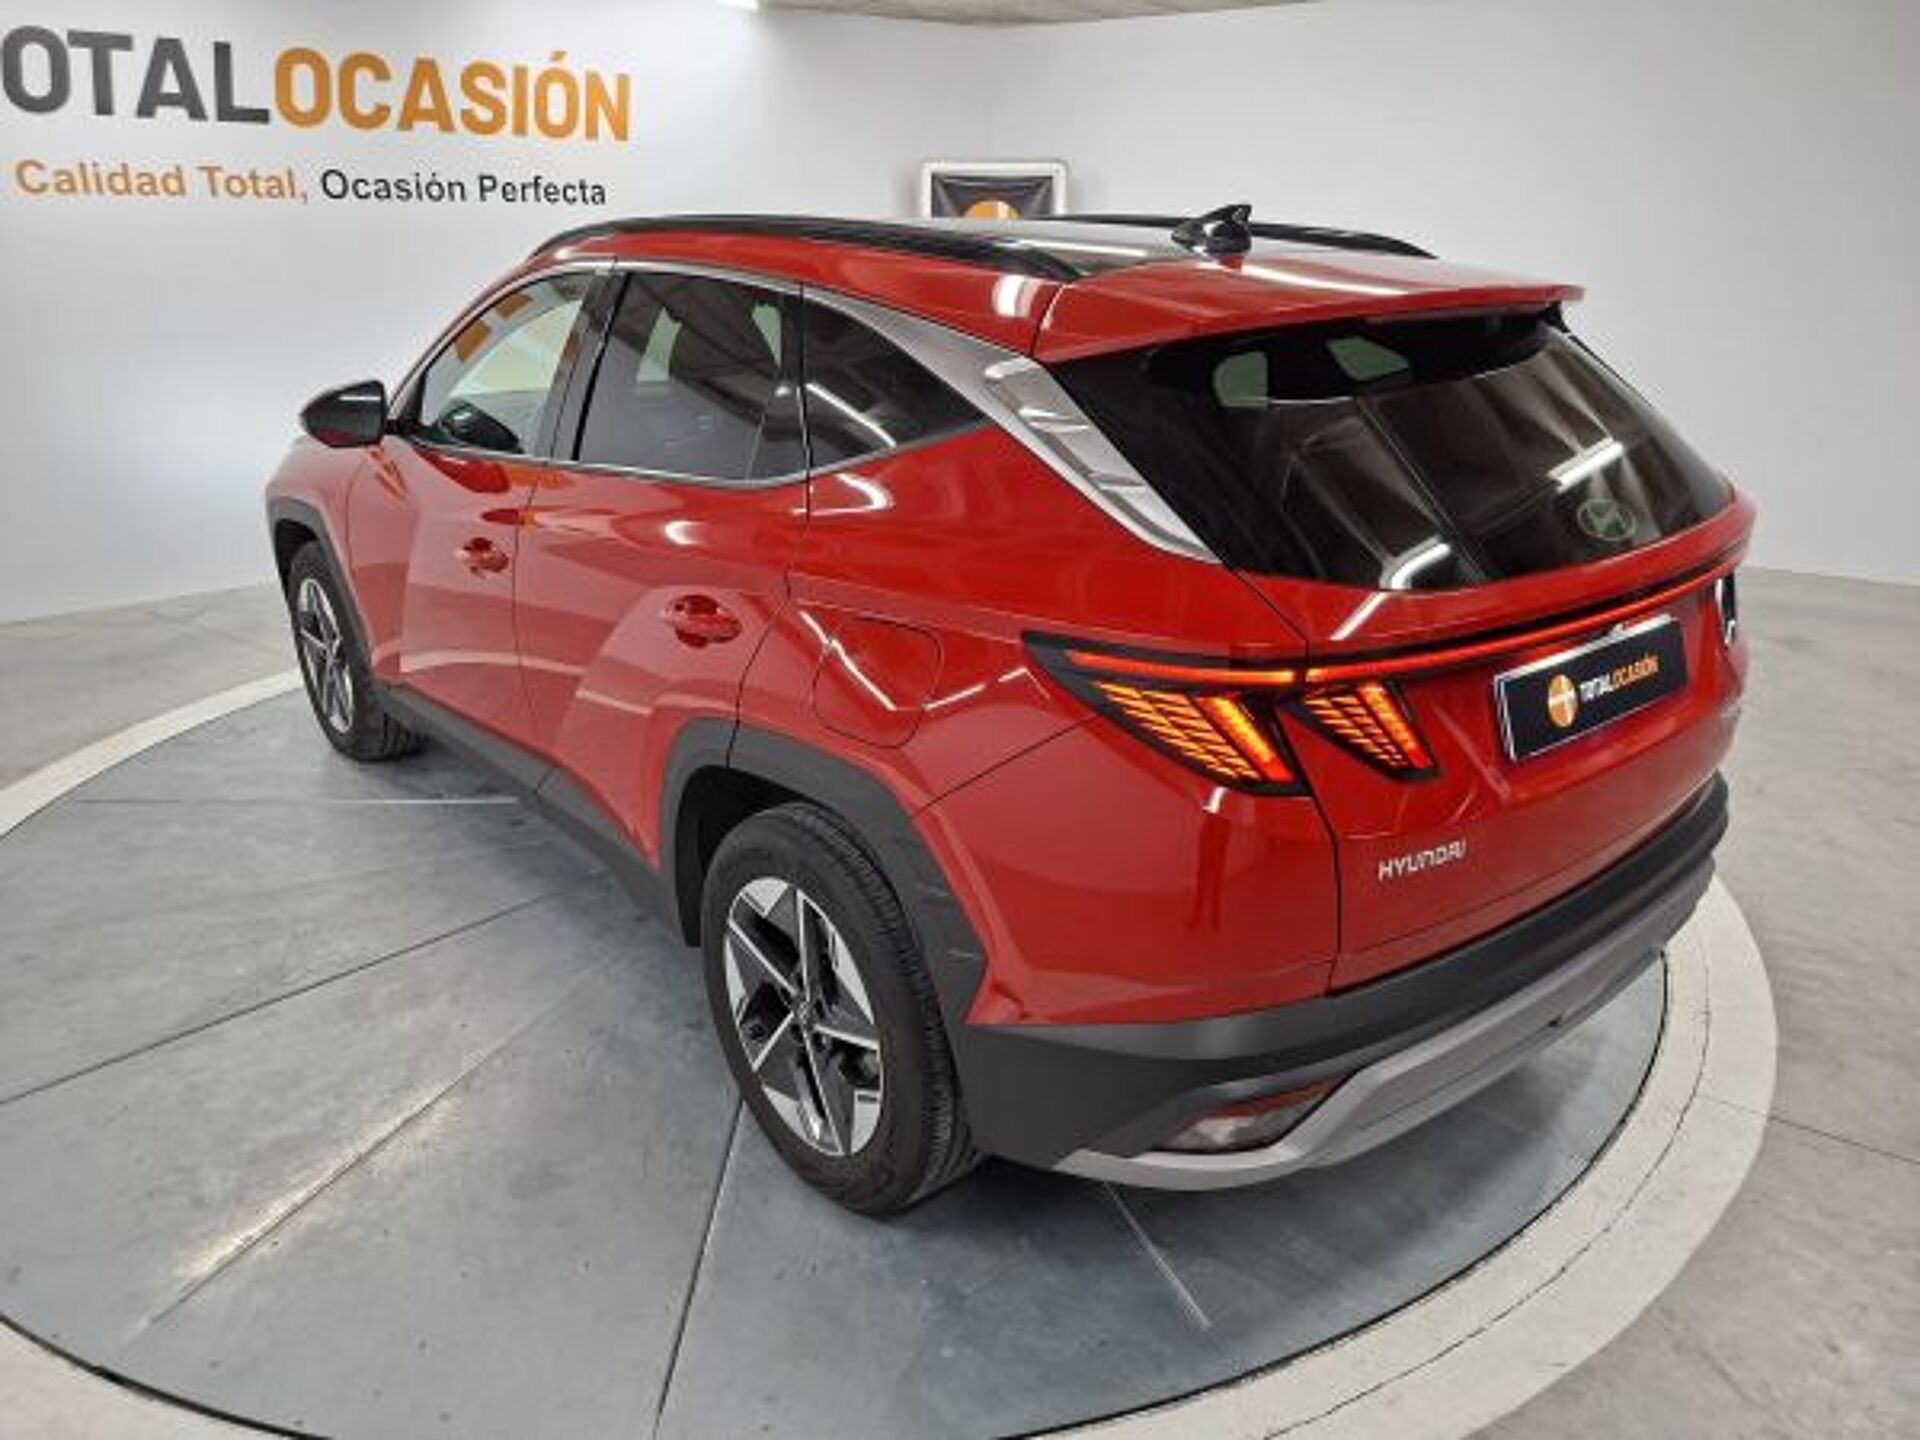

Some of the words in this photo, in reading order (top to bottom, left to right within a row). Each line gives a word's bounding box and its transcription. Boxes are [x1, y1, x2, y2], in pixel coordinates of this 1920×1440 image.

[15, 159, 187, 198] Calidad
[198, 164, 308, 205] Total,
[320, 168, 467, 204] Ocasión
[478, 175, 607, 206] Perfecta
[1378, 838, 1467, 882] HYUNDAI
